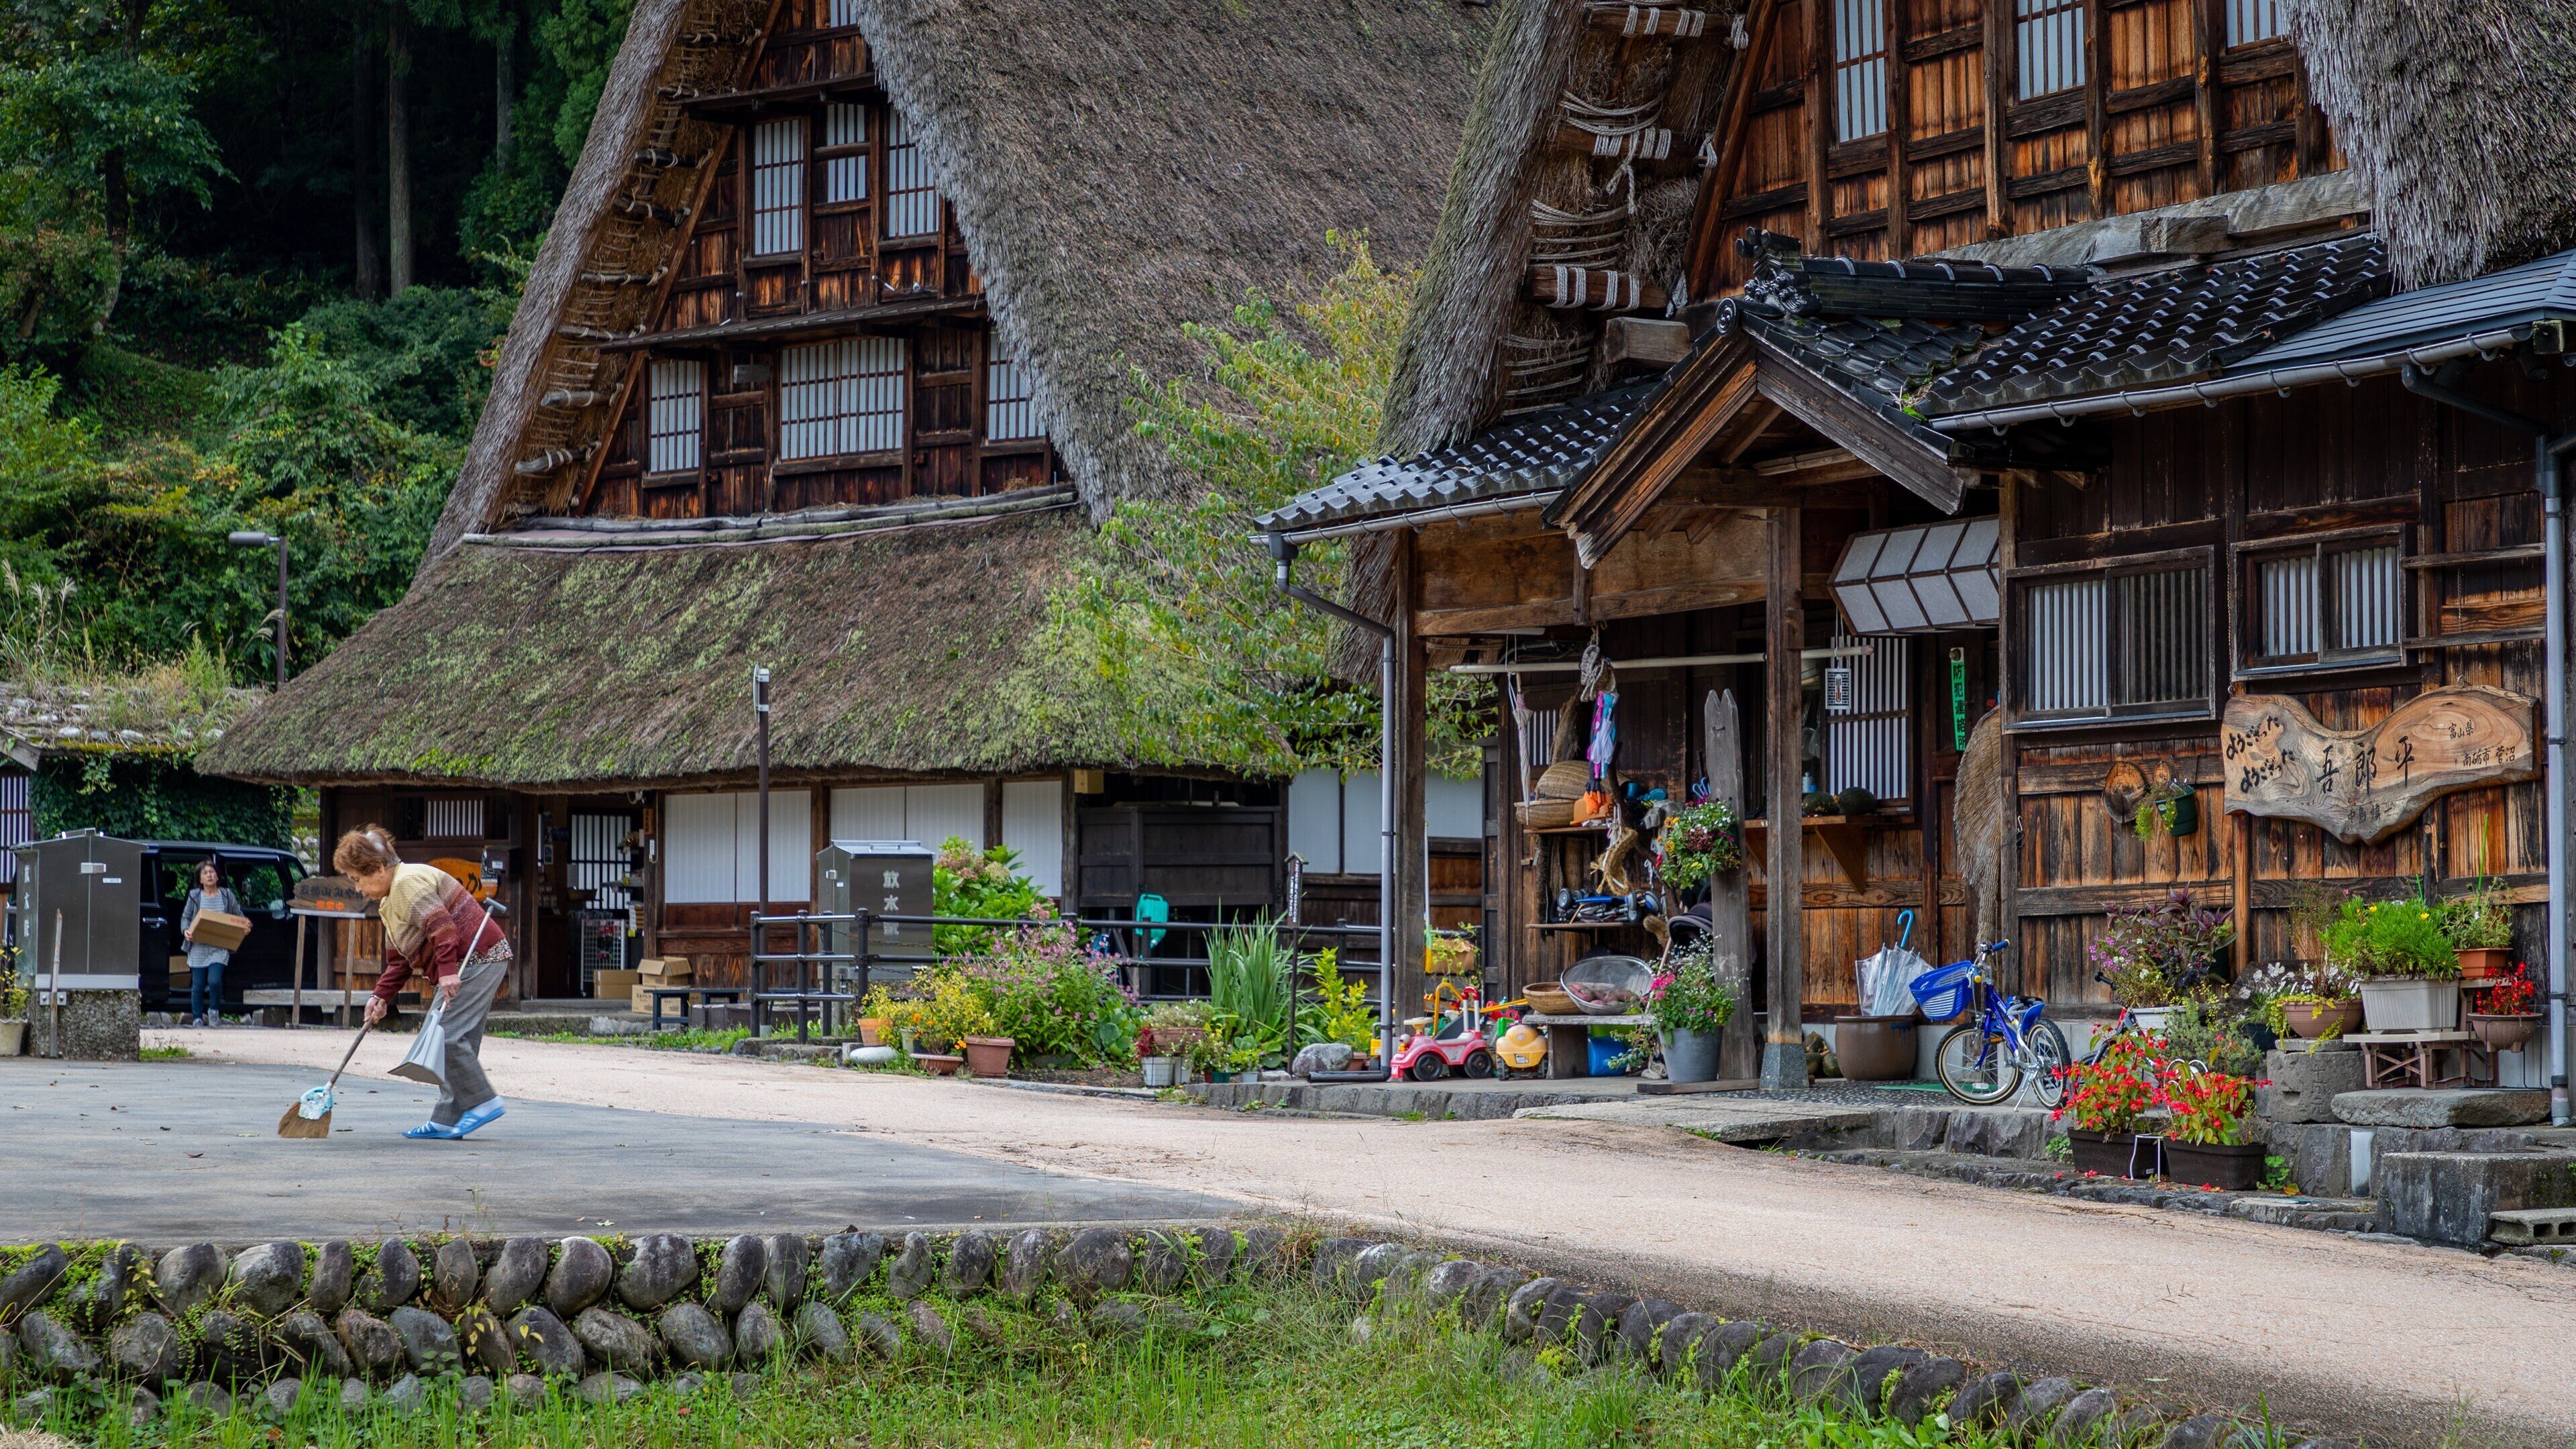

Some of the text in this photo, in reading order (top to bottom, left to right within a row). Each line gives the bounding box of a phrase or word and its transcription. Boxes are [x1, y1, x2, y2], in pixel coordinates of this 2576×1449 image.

[1952, 664, 1966, 750] 防犯連絡所
[2448, 719, 2474, 739] 富山県
[2316, 735, 2415, 795] 吾郎平
[2463, 745, 2516, 767] 南砺市 菅沼
